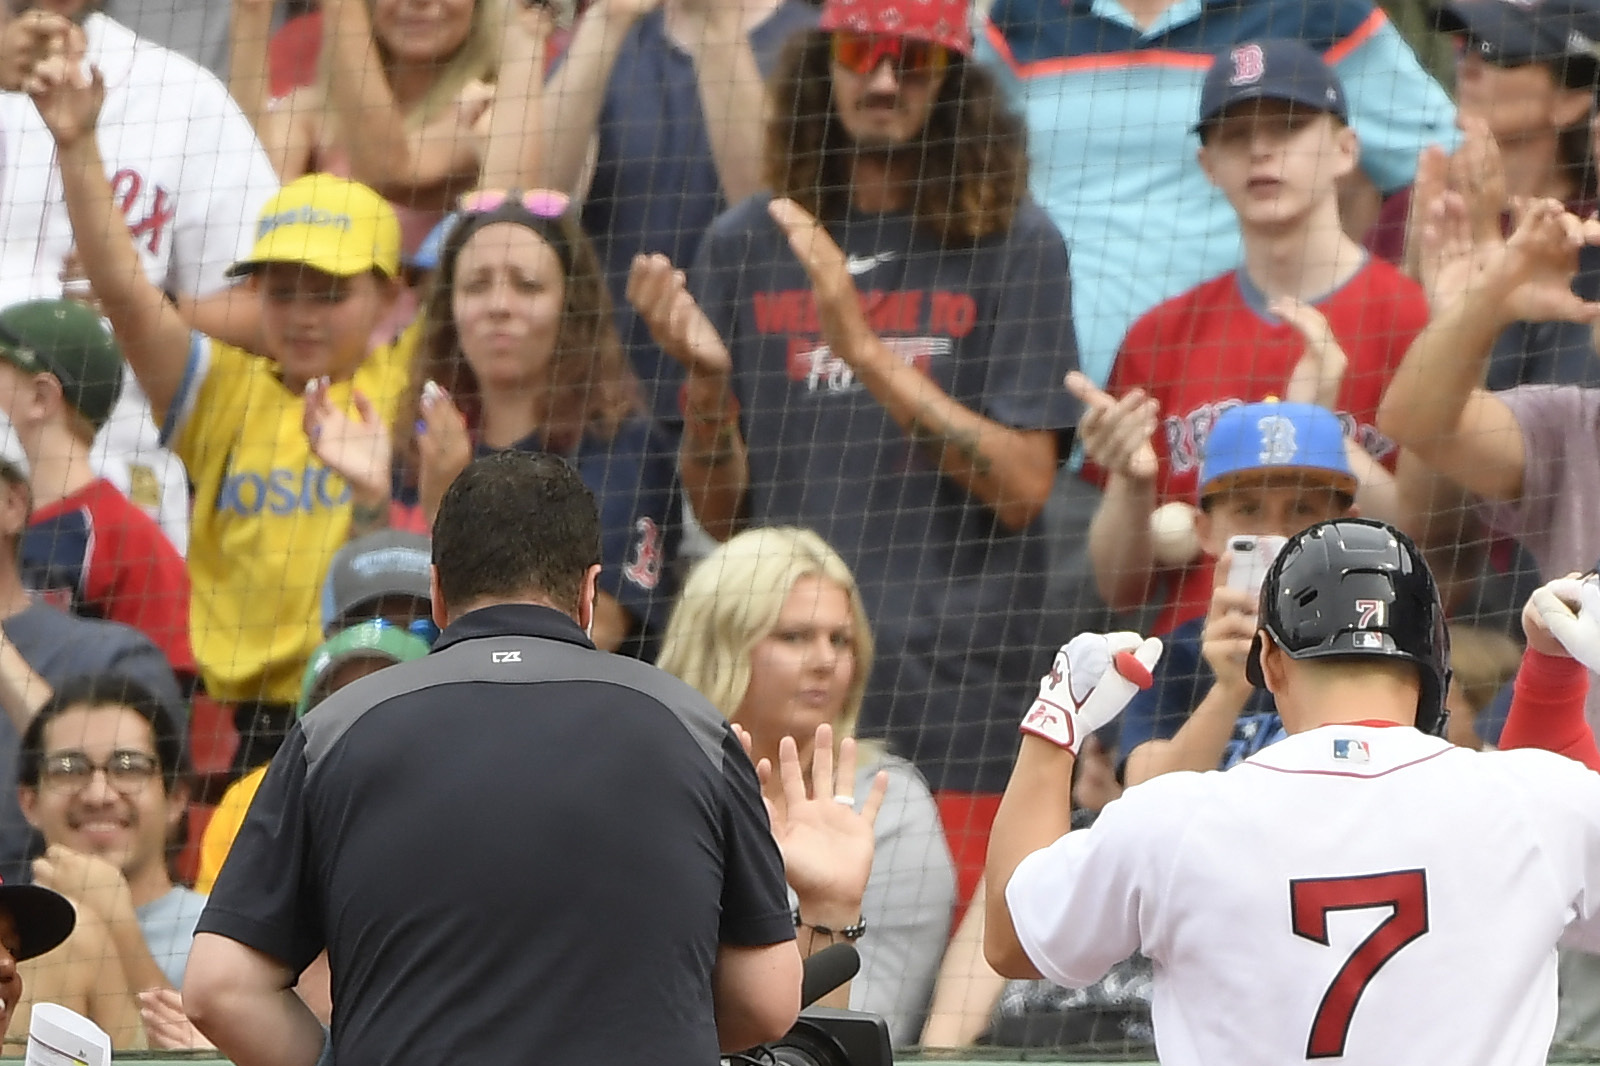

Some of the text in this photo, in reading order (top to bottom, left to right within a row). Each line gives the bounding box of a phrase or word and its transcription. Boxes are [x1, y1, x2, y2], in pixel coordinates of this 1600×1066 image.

[1230, 44, 1265, 86] B
[1256, 414, 1298, 465] B
[1355, 599, 1379, 629] 7
[1289, 866, 1431, 1061] 7
